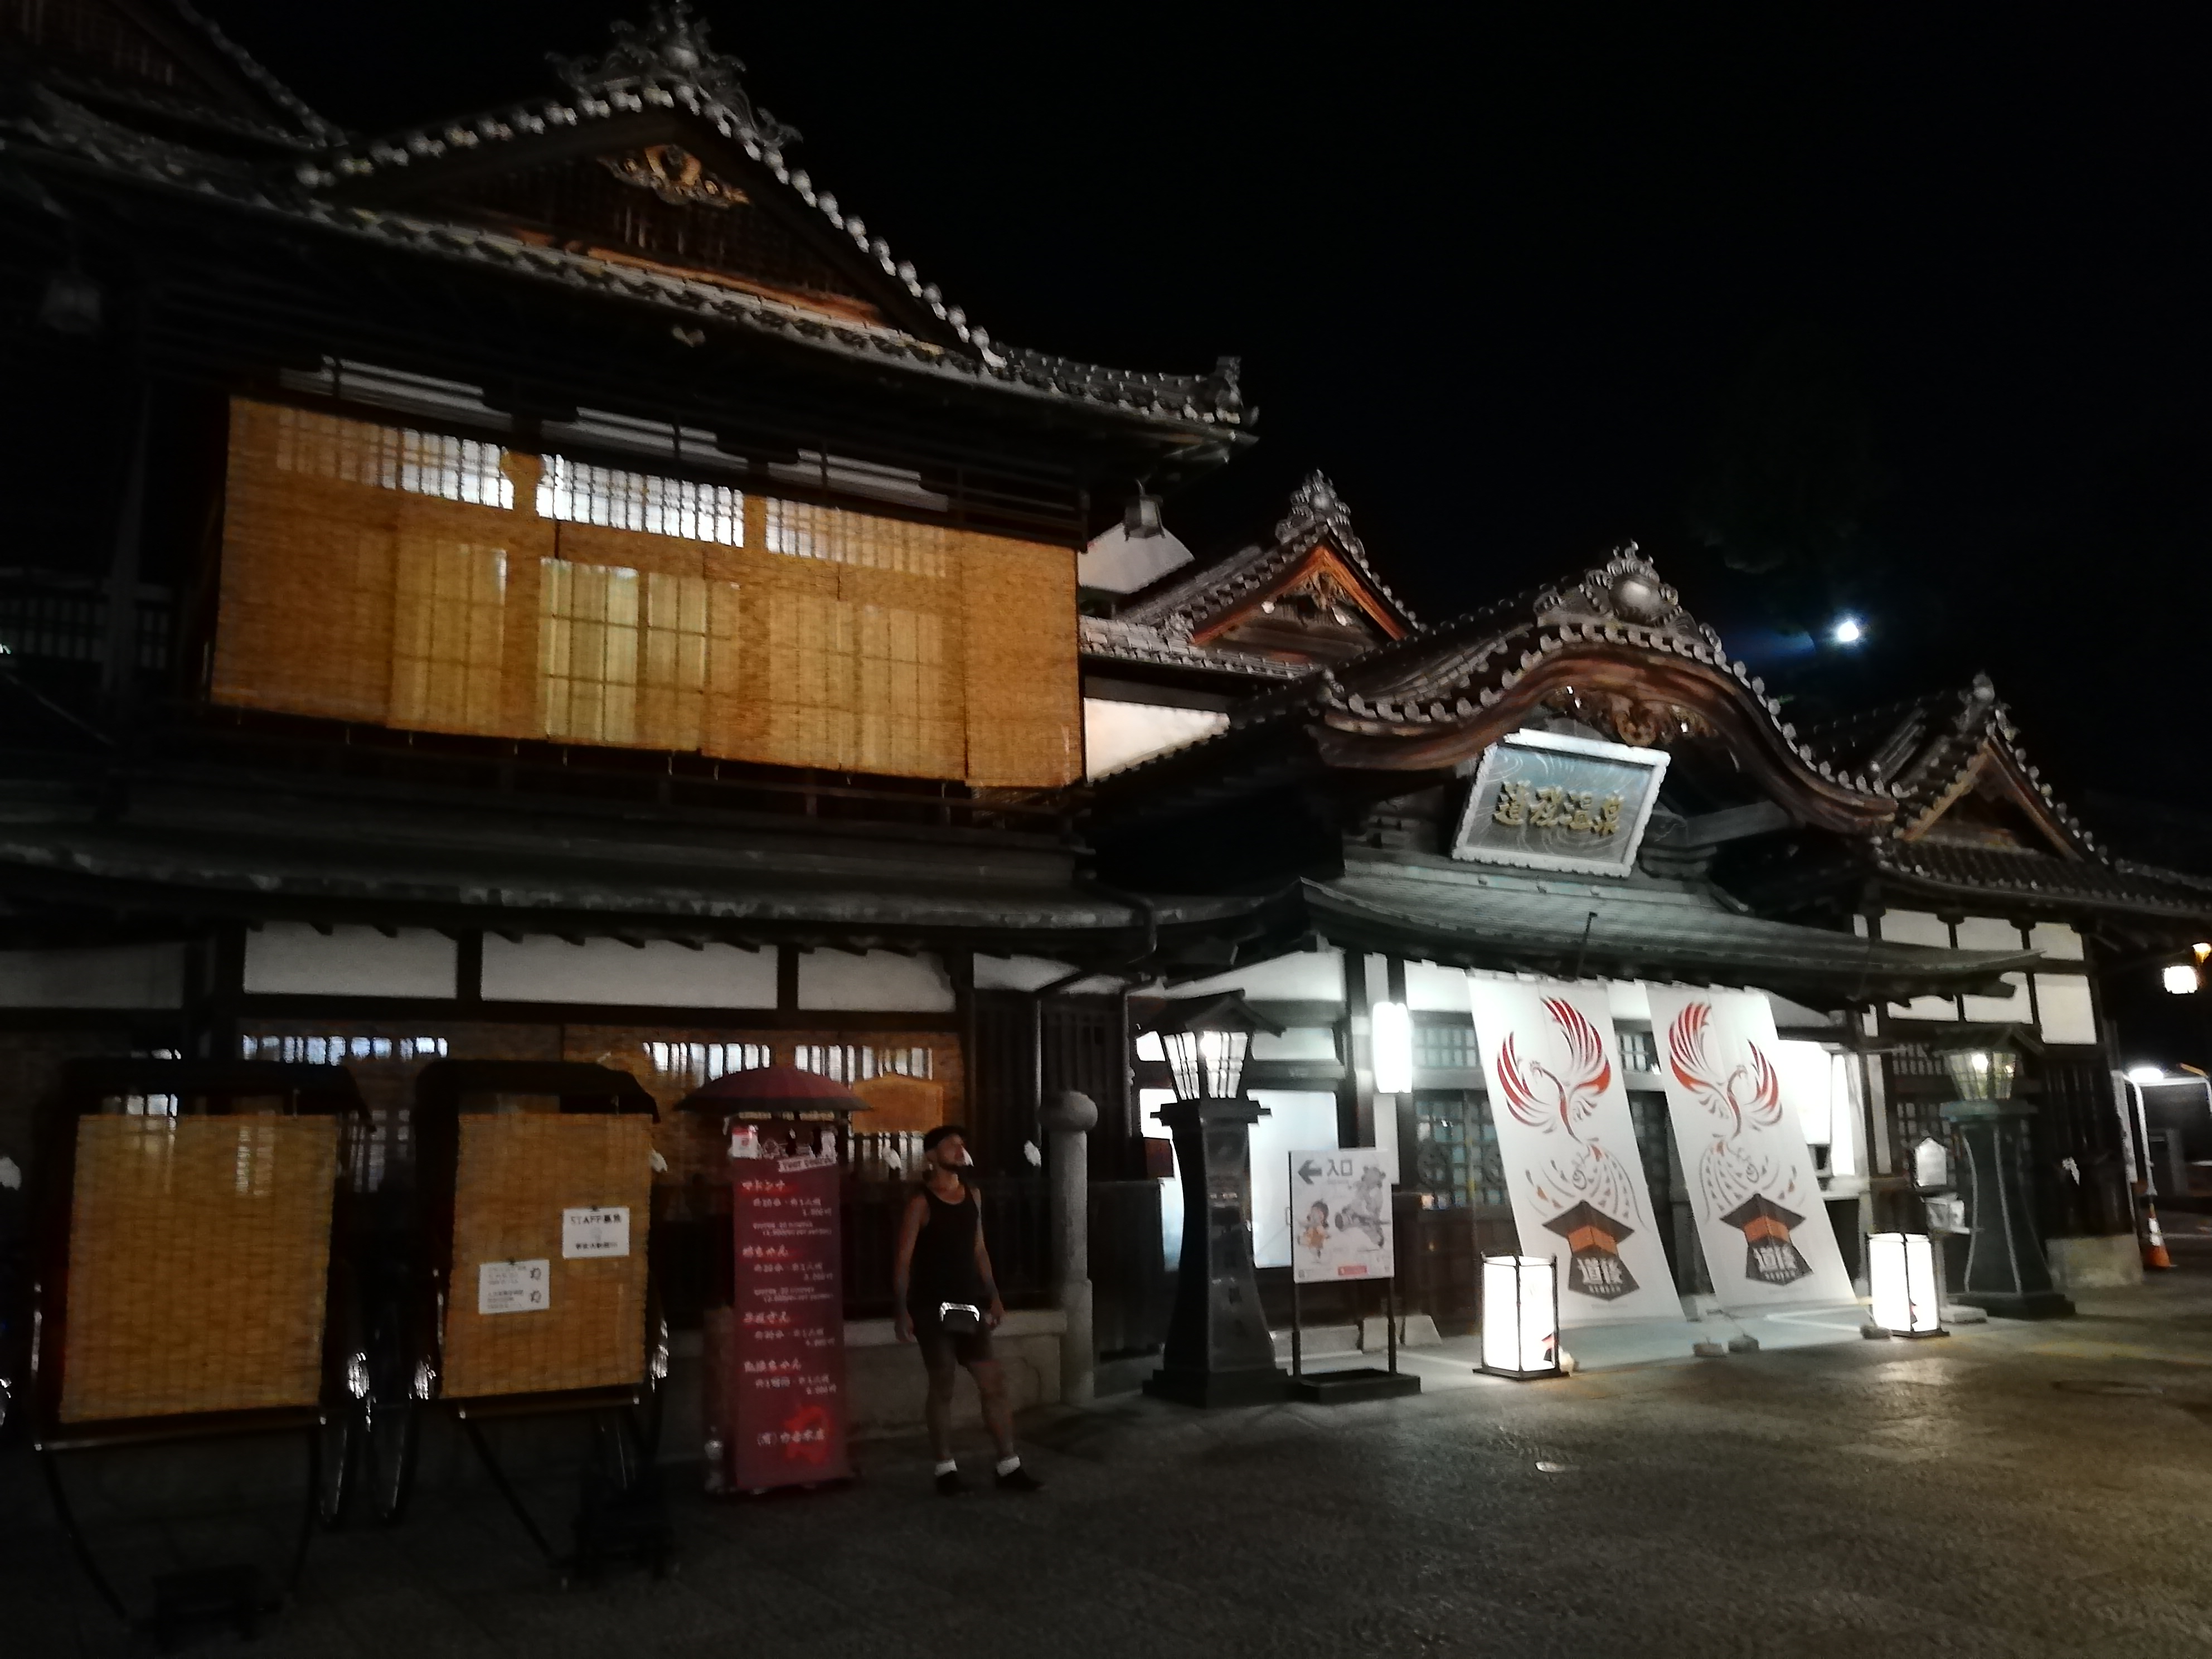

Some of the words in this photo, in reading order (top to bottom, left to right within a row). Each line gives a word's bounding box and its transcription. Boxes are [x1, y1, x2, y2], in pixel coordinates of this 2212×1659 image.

[1492, 779, 1624, 837] 道後温泉
[1327, 1158, 1353, 1177] 入口
[1576, 1257, 1623, 1286] 道後
[1753, 1244, 1797, 1273] 道後
